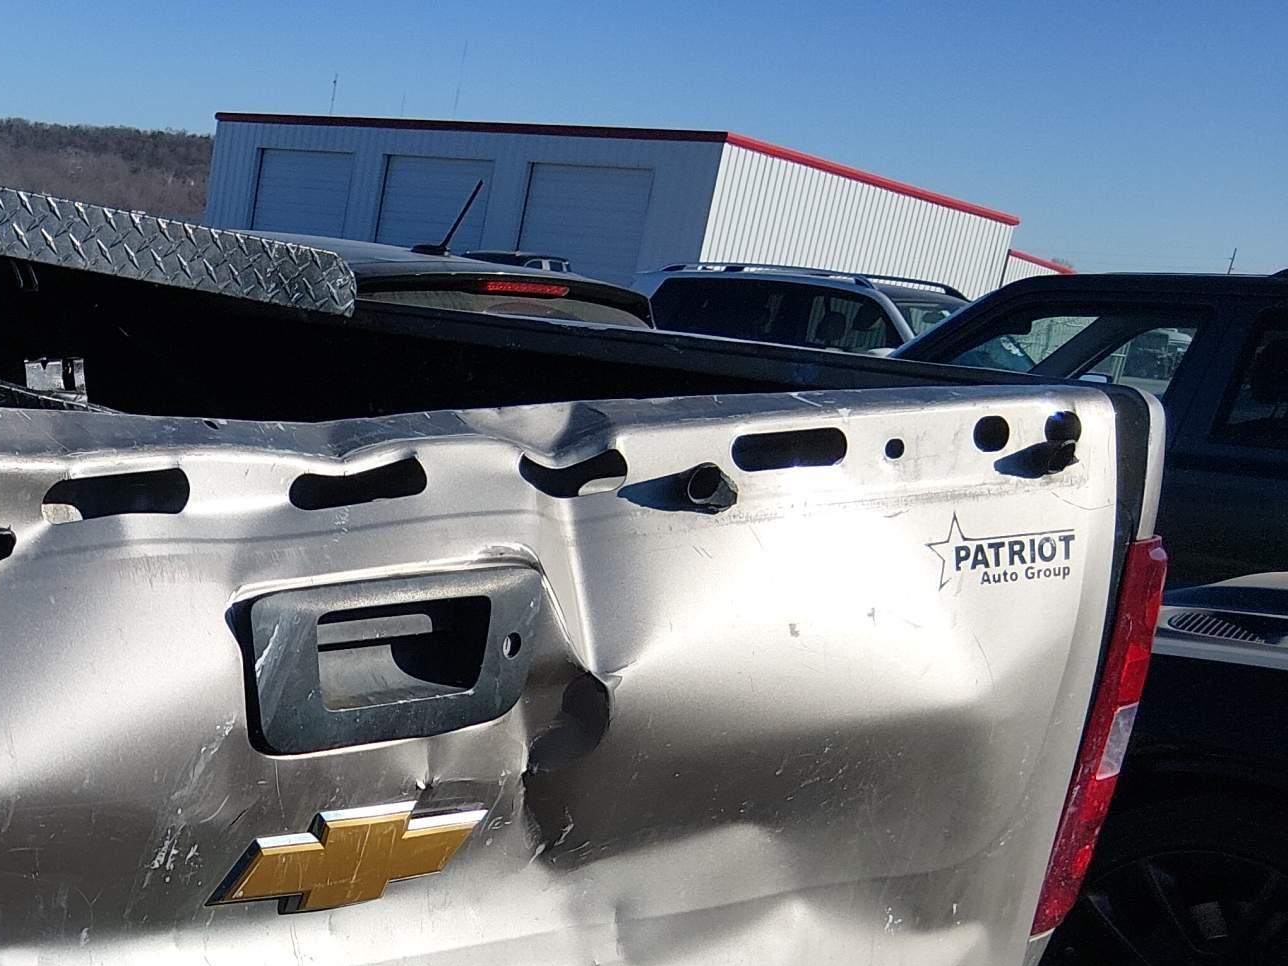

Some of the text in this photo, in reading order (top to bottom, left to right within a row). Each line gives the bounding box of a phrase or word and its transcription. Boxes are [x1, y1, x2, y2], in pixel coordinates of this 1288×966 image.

[954, 534, 1076, 572] PATRIOT
[980, 565, 1071, 585] Auto Group
